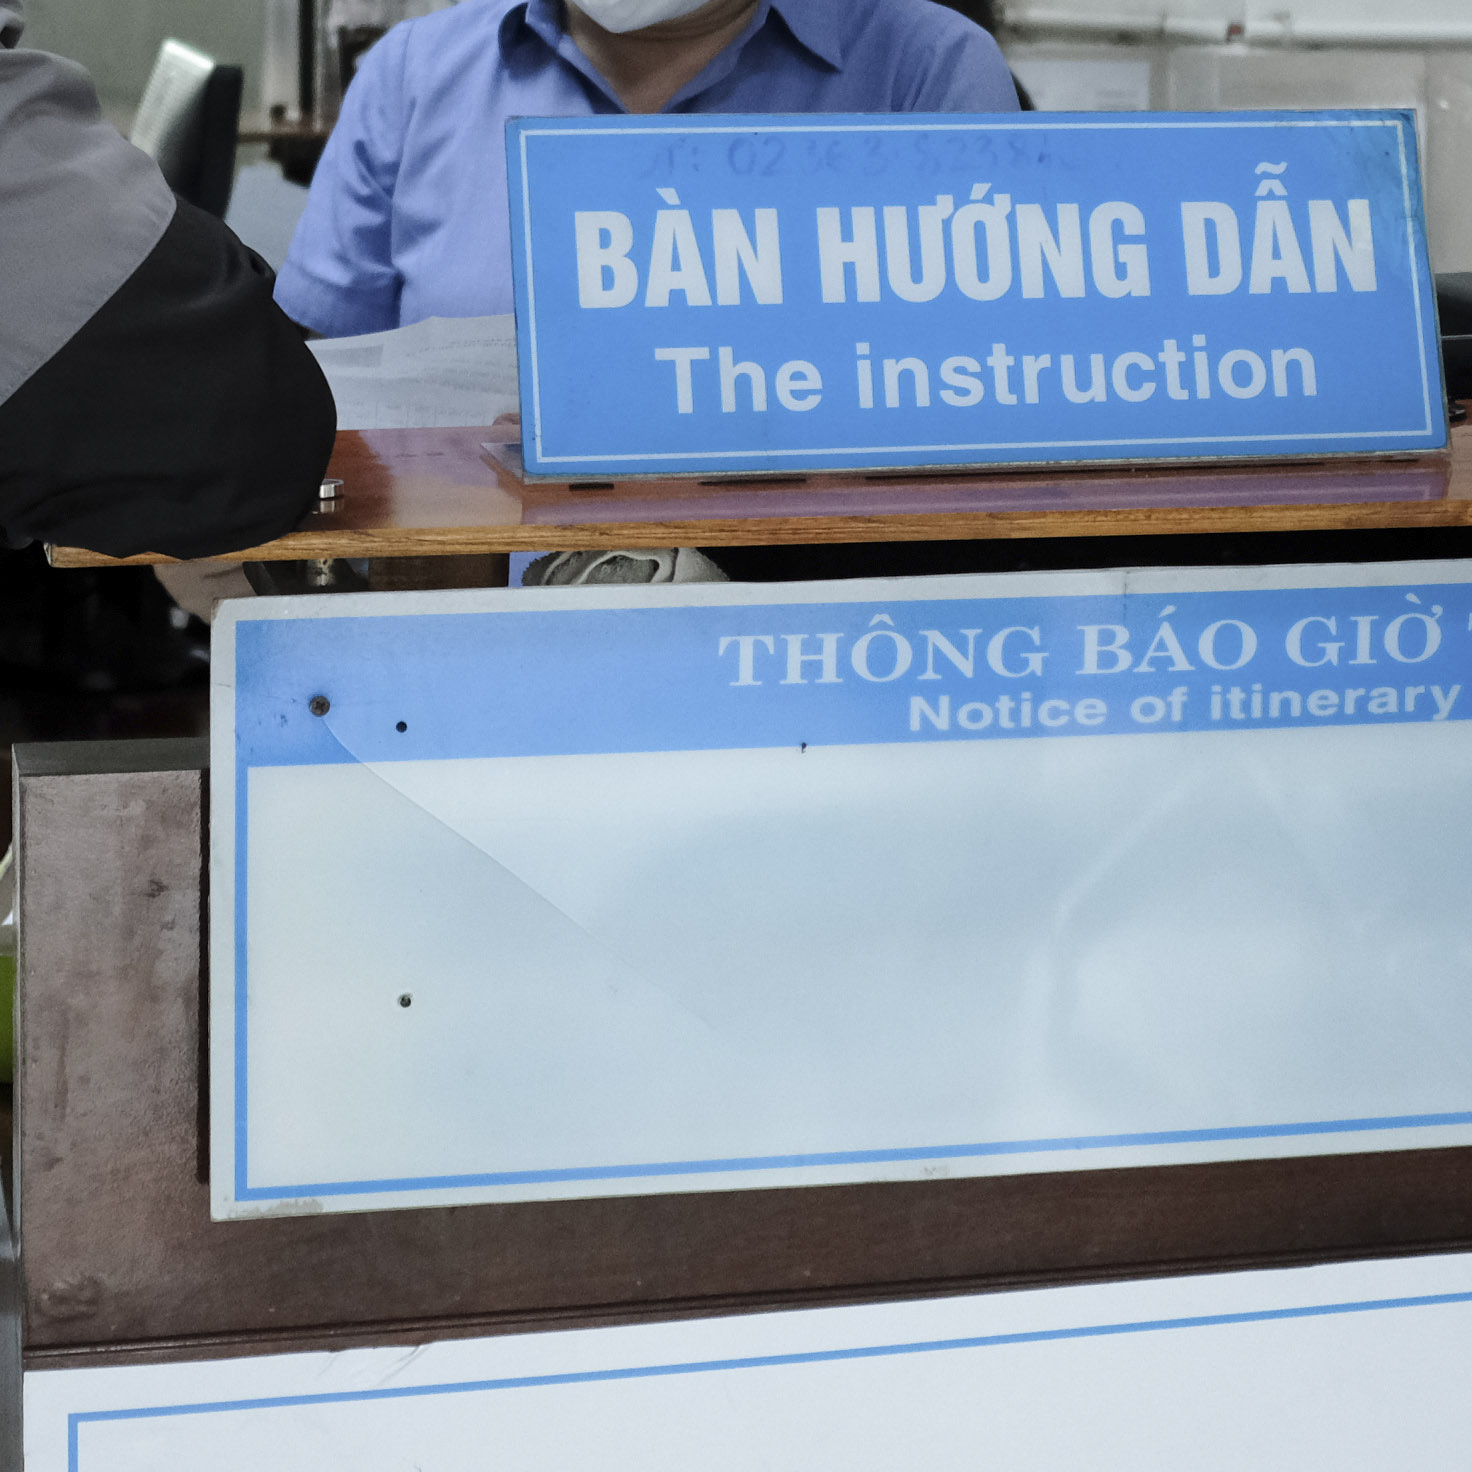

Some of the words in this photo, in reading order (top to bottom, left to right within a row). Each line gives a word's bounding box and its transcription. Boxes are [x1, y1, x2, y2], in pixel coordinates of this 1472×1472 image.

[574, 187, 783, 309] BÀN
[816, 183, 1151, 304] HƯỚNG
[1181, 161, 1378, 296] DẪN
[654, 346, 822, 414] The
[855, 334, 1318, 410] instruction
[718, 613, 1050, 686] THÔNG
[1075, 605, 1258, 675] BÁO
[1284, 592, 1443, 667] GIỜ
[909, 691, 1108, 731] Notice
[1130, 686, 1189, 725] of
[1210, 683, 1462, 721] itinerary
